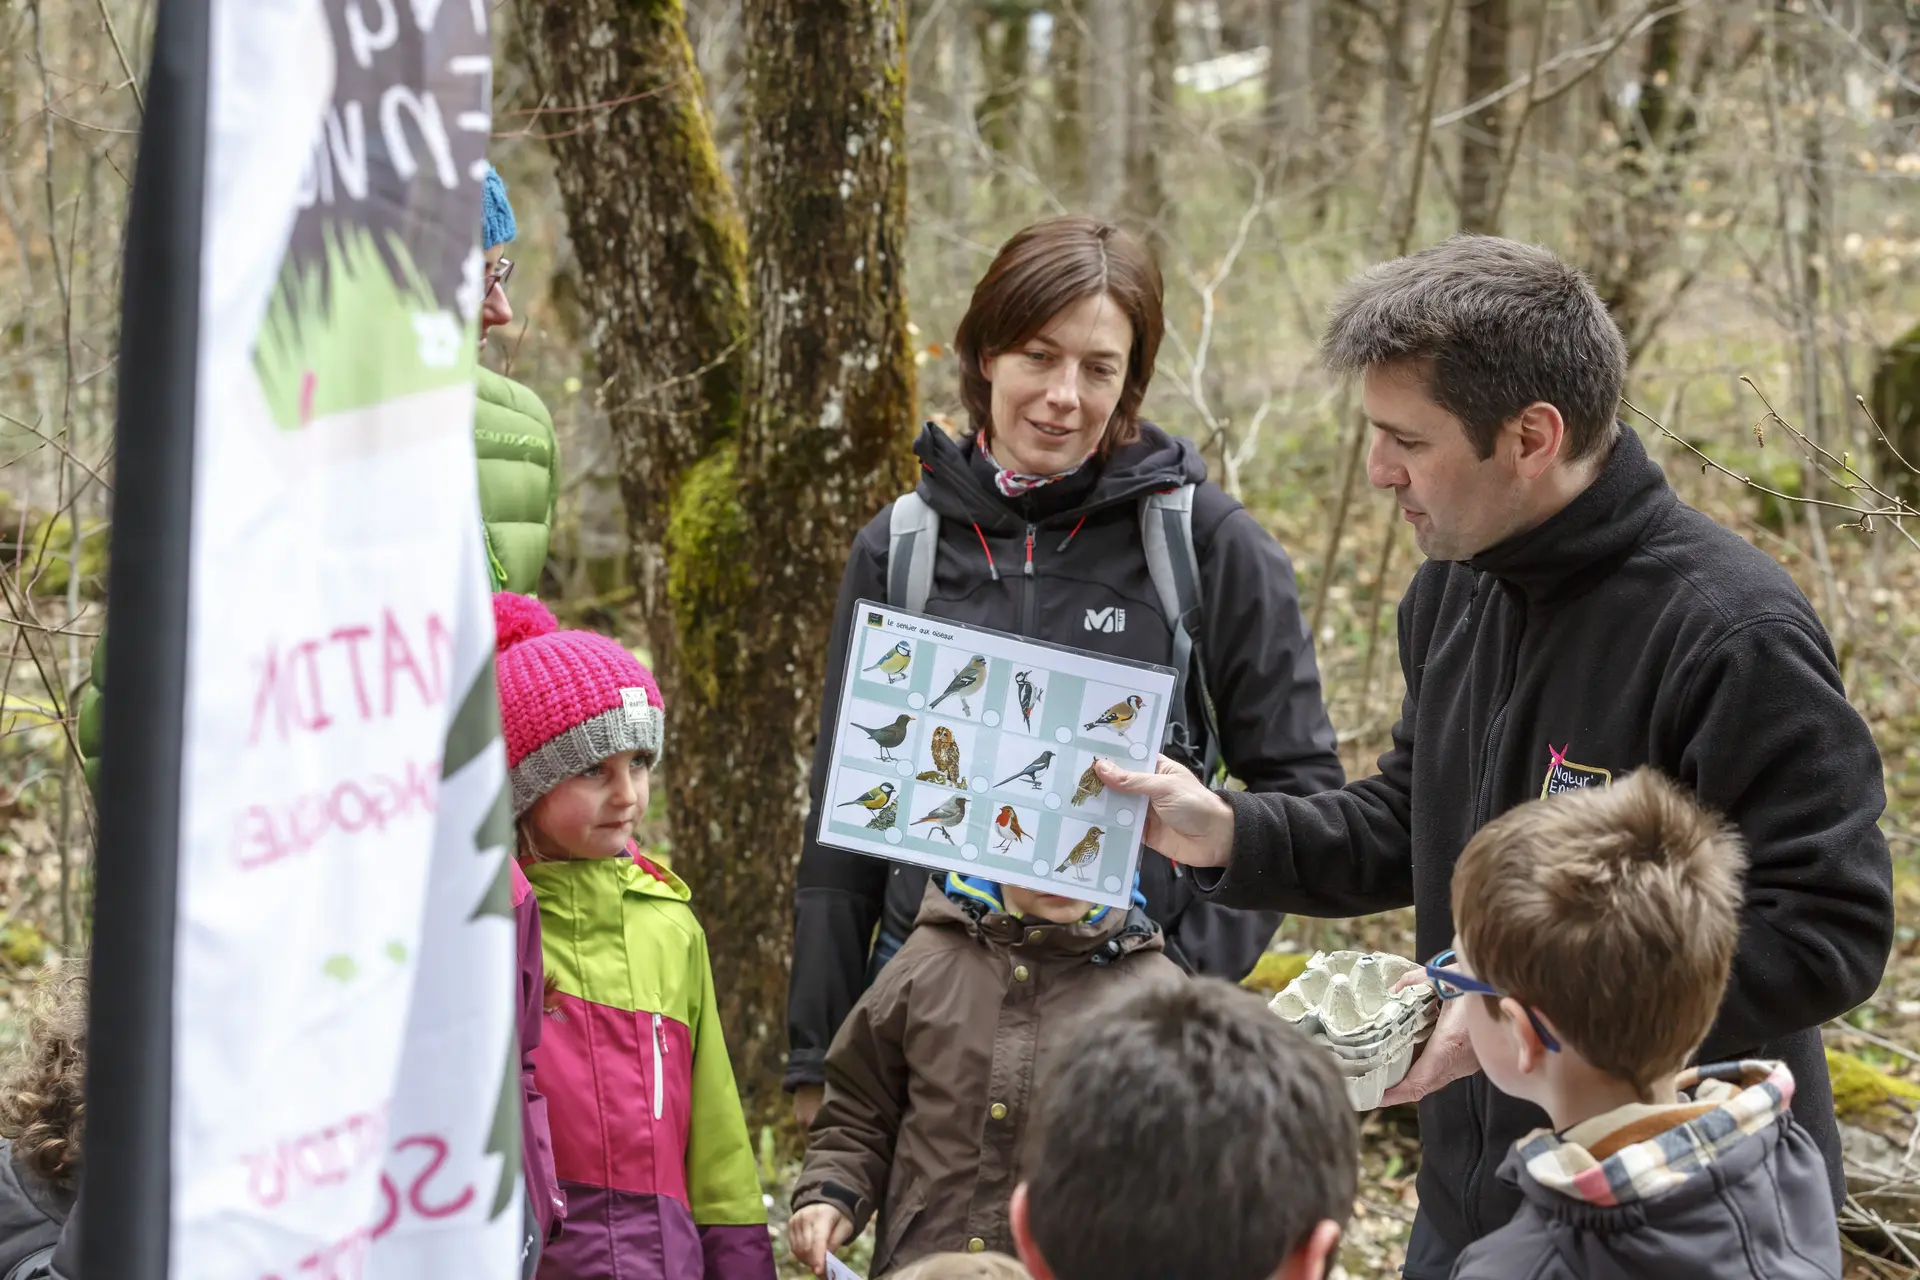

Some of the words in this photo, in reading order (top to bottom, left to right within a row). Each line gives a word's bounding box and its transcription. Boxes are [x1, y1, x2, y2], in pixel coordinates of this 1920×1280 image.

[886, 618, 894, 627] Le
[896, 620, 917, 632] sentier
[919, 627, 930, 636] aux
[931, 630, 954, 641] oiseaux
